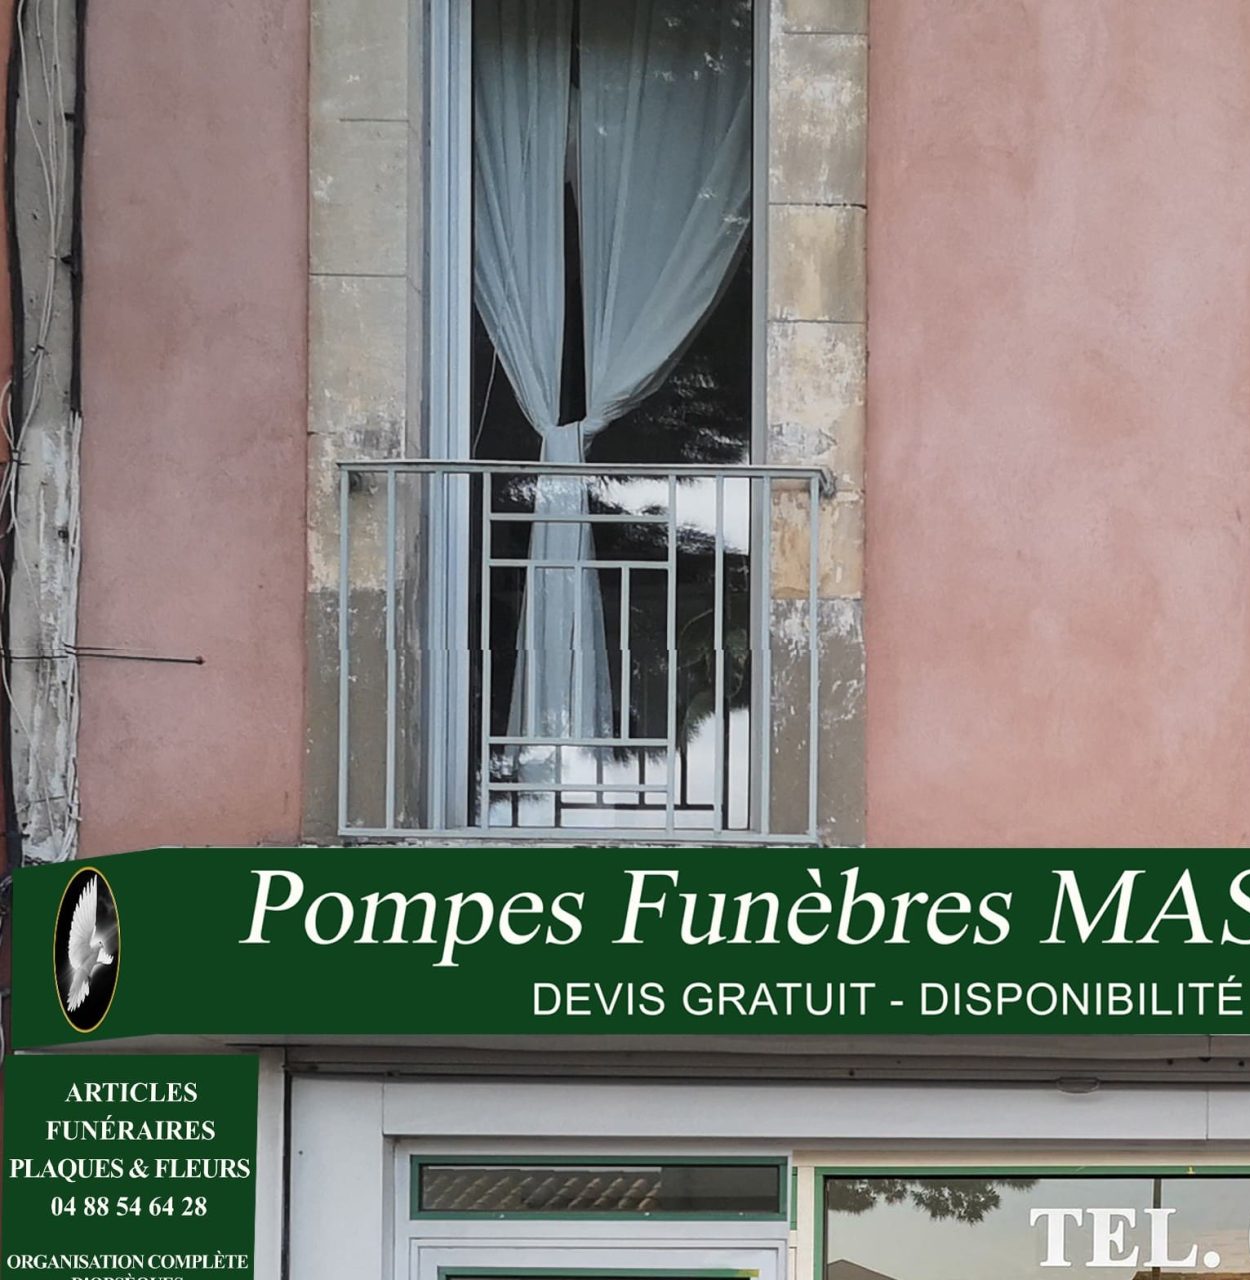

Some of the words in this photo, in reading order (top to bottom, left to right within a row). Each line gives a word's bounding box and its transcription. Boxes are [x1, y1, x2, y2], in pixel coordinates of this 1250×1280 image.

[238, 869, 585, 967] Pompes
[611, 866, 1013, 945] Funèbres
[533, 982, 665, 1016] DEVIS
[682, 982, 876, 1016] GRATUIT
[921, 977, 1244, 1016] DISPONIBILITÉ
[65, 1082, 198, 1103] ARTICLES
[46, 1114, 216, 1141] FUNÉRAIRES
[9, 1158, 124, 1183] PLAQUES
[128, 1158, 150, 1179] &
[154, 1158, 251, 1179] FLEURS
[50, 1196, 77, 1217] 04
[83, 1196, 109, 1217] 88
[116, 1196, 142, 1217] 54
[148, 1196, 175, 1217] 64
[181, 1196, 208, 1217] 28
[1029, 1207, 1221, 1268] TEL.
[6, 1254, 144, 1270] ORGANISATION
[147, 1250, 249, 1270] COMPLÈTE
